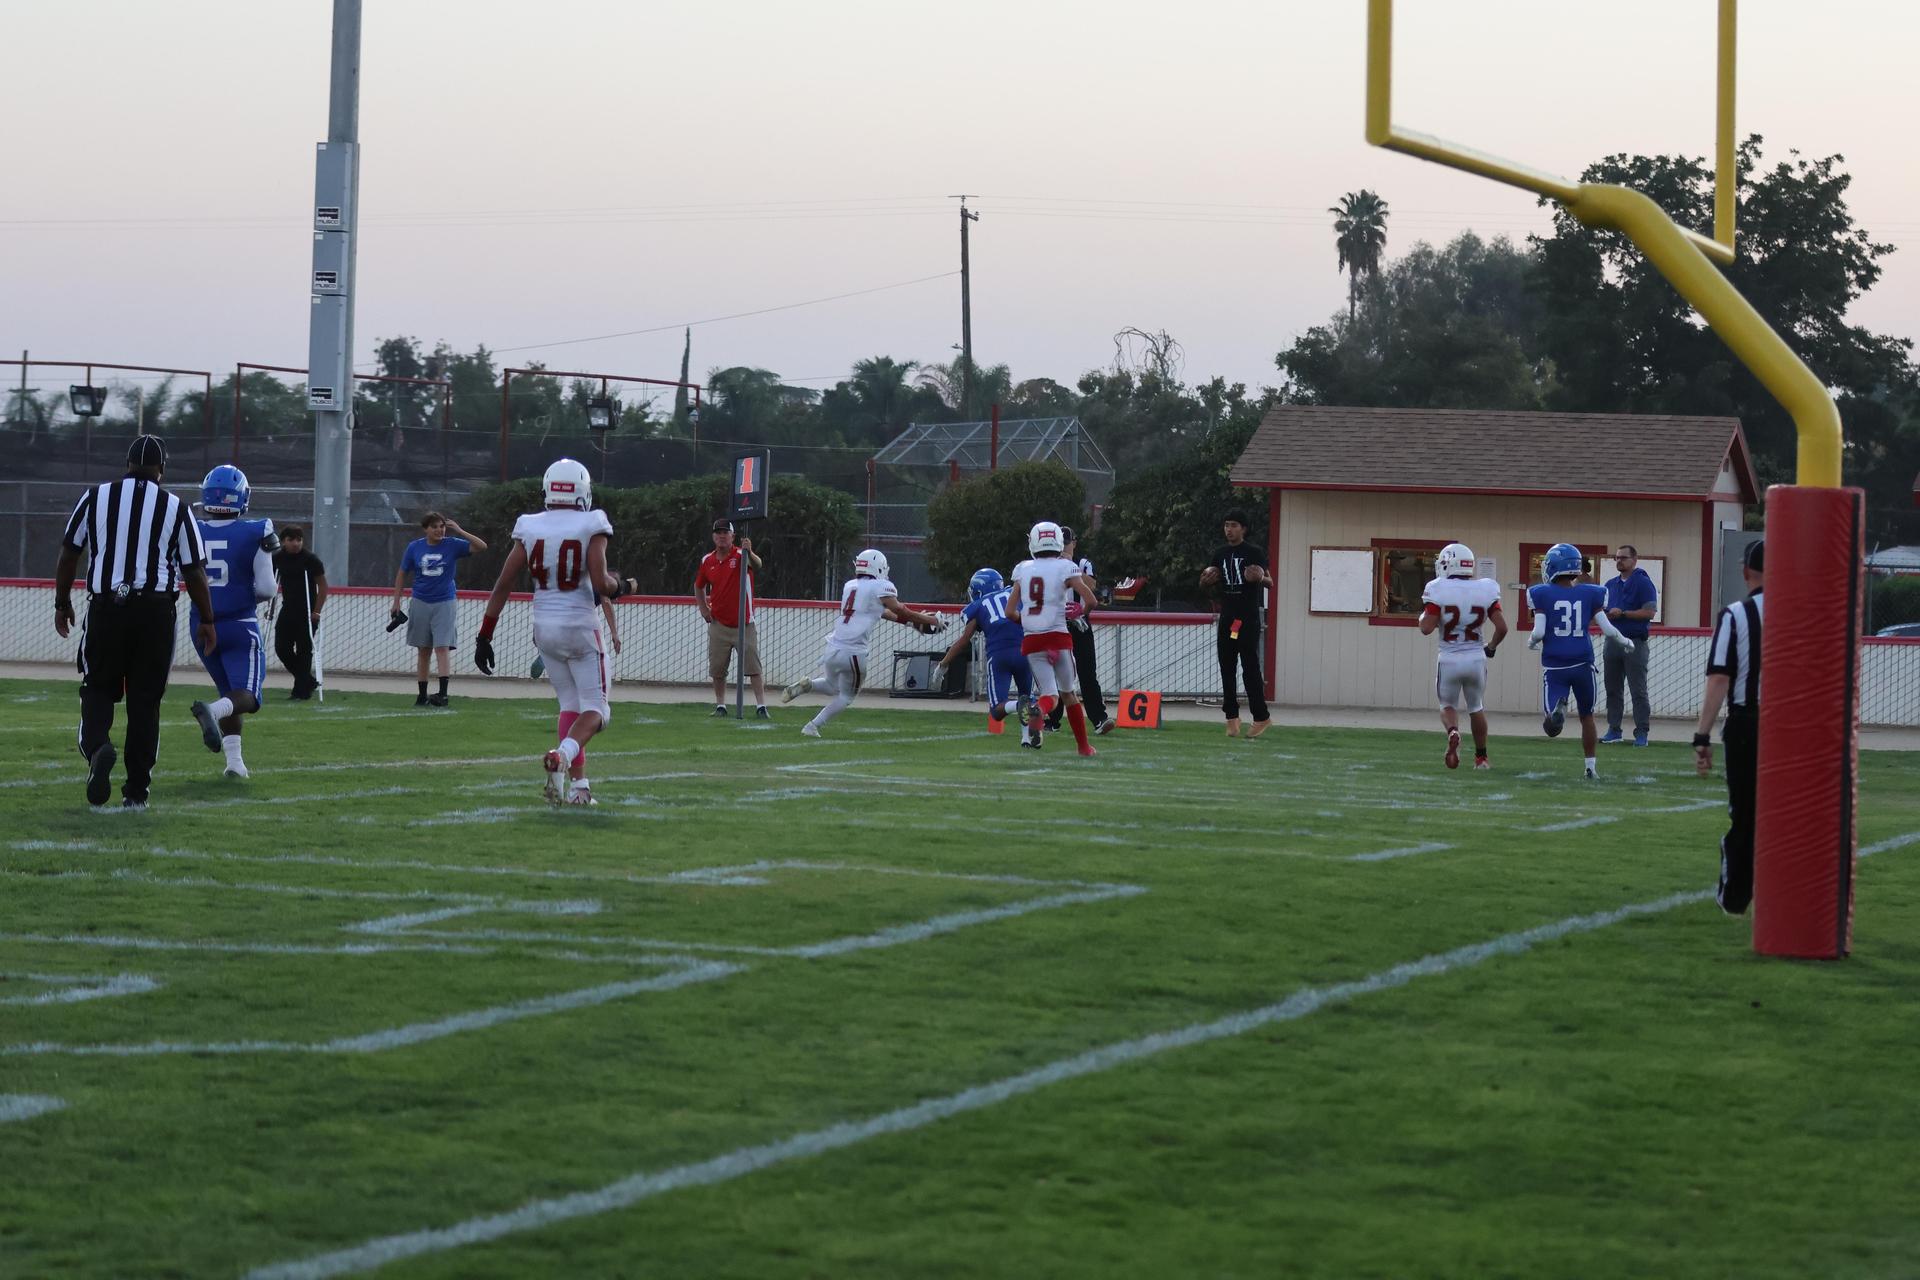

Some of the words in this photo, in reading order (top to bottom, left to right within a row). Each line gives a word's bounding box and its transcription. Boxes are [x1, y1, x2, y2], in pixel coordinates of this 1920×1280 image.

[740, 457, 753, 493] 1
[204, 540, 229, 587] 5
[528, 539, 582, 591] 40
[843, 589, 856, 624] 4
[981, 591, 1011, 624] 10
[1028, 576, 1045, 616] 9
[1443, 605, 1485, 642] 22
[1553, 600, 1584, 637] 31
[1128, 693, 1148, 721] G
